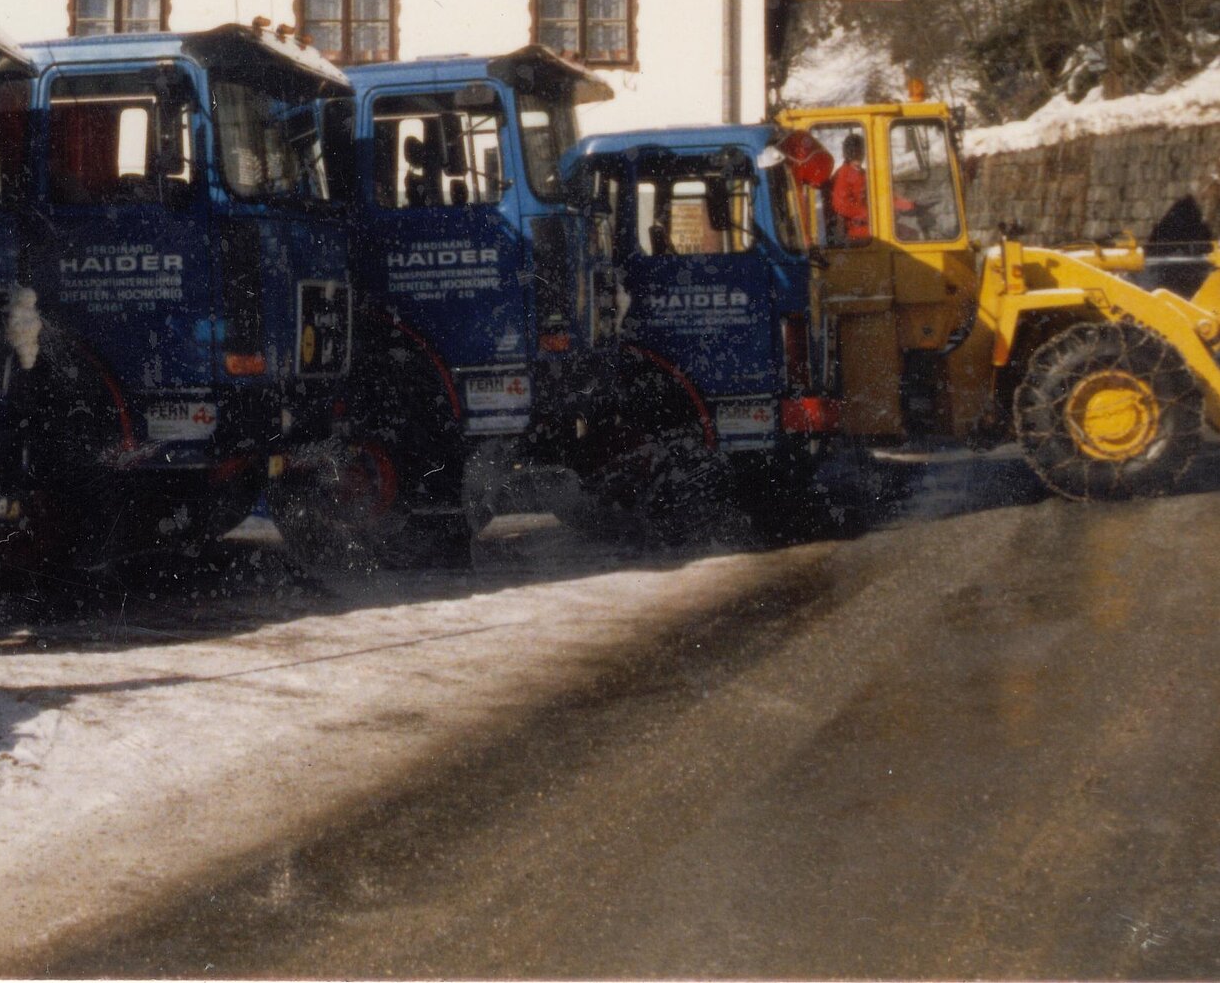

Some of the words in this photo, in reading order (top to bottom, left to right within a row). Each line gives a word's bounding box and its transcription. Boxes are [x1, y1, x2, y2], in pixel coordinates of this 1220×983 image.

[86, 244, 154, 256] FERDINAND
[387, 249, 499, 267] HAIDER
[60, 255, 184, 272] HAIDER
[649, 292, 749, 308] HAIDER
